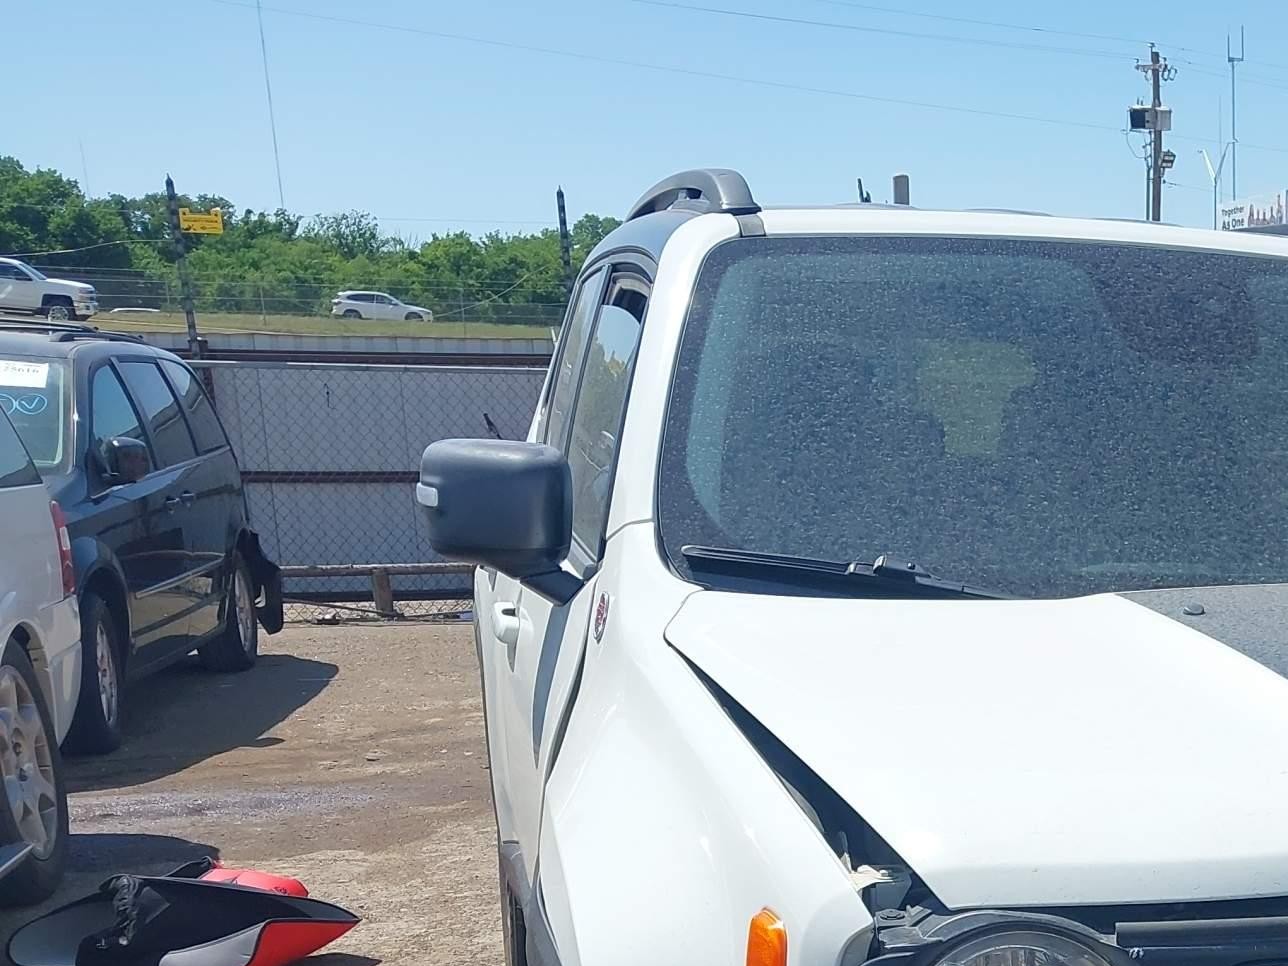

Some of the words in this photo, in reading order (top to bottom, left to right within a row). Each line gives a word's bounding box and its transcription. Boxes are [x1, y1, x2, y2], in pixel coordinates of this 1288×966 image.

[1222, 206, 1244, 218] Together
[1222, 220, 1230, 231] As
[1232, 218, 1244, 228] One
